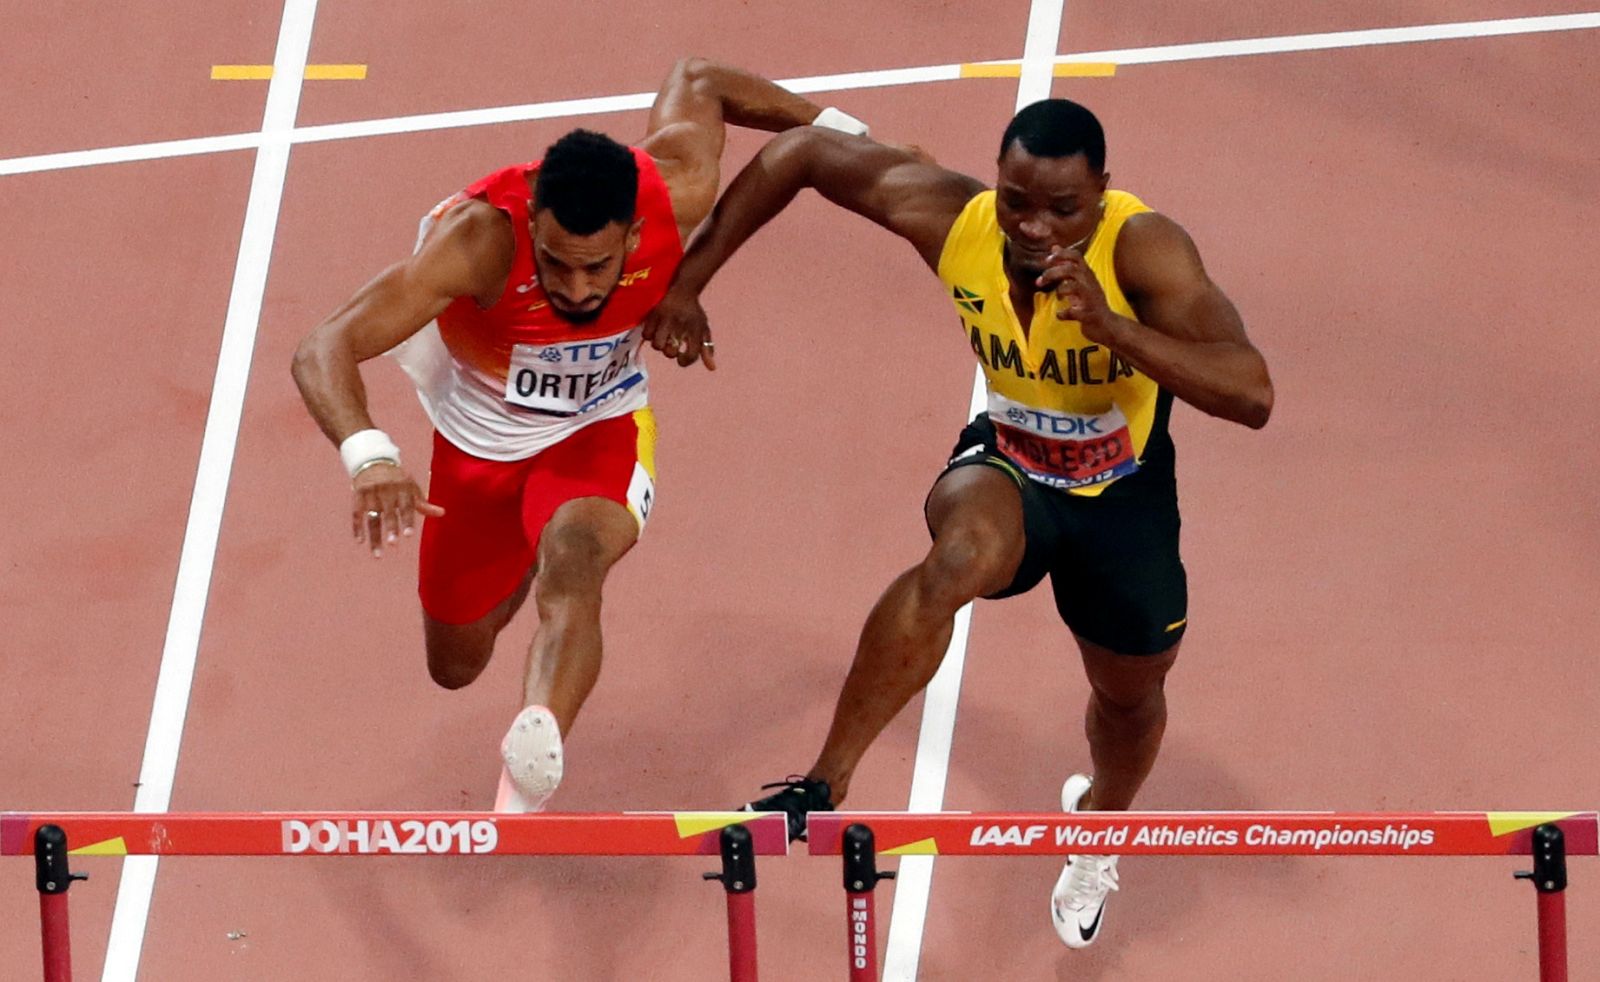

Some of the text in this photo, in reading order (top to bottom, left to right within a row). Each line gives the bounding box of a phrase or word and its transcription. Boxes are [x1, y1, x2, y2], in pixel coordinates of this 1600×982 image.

[960, 316, 1134, 386] AMAICA
[516, 350, 629, 399] ORTEGA
[1026, 410, 1103, 435] TDK
[281, 820, 498, 854] DOHA2019
[970, 824, 1435, 850] IAAF World Athletics Championships
[852, 910, 868, 969] MONDO
